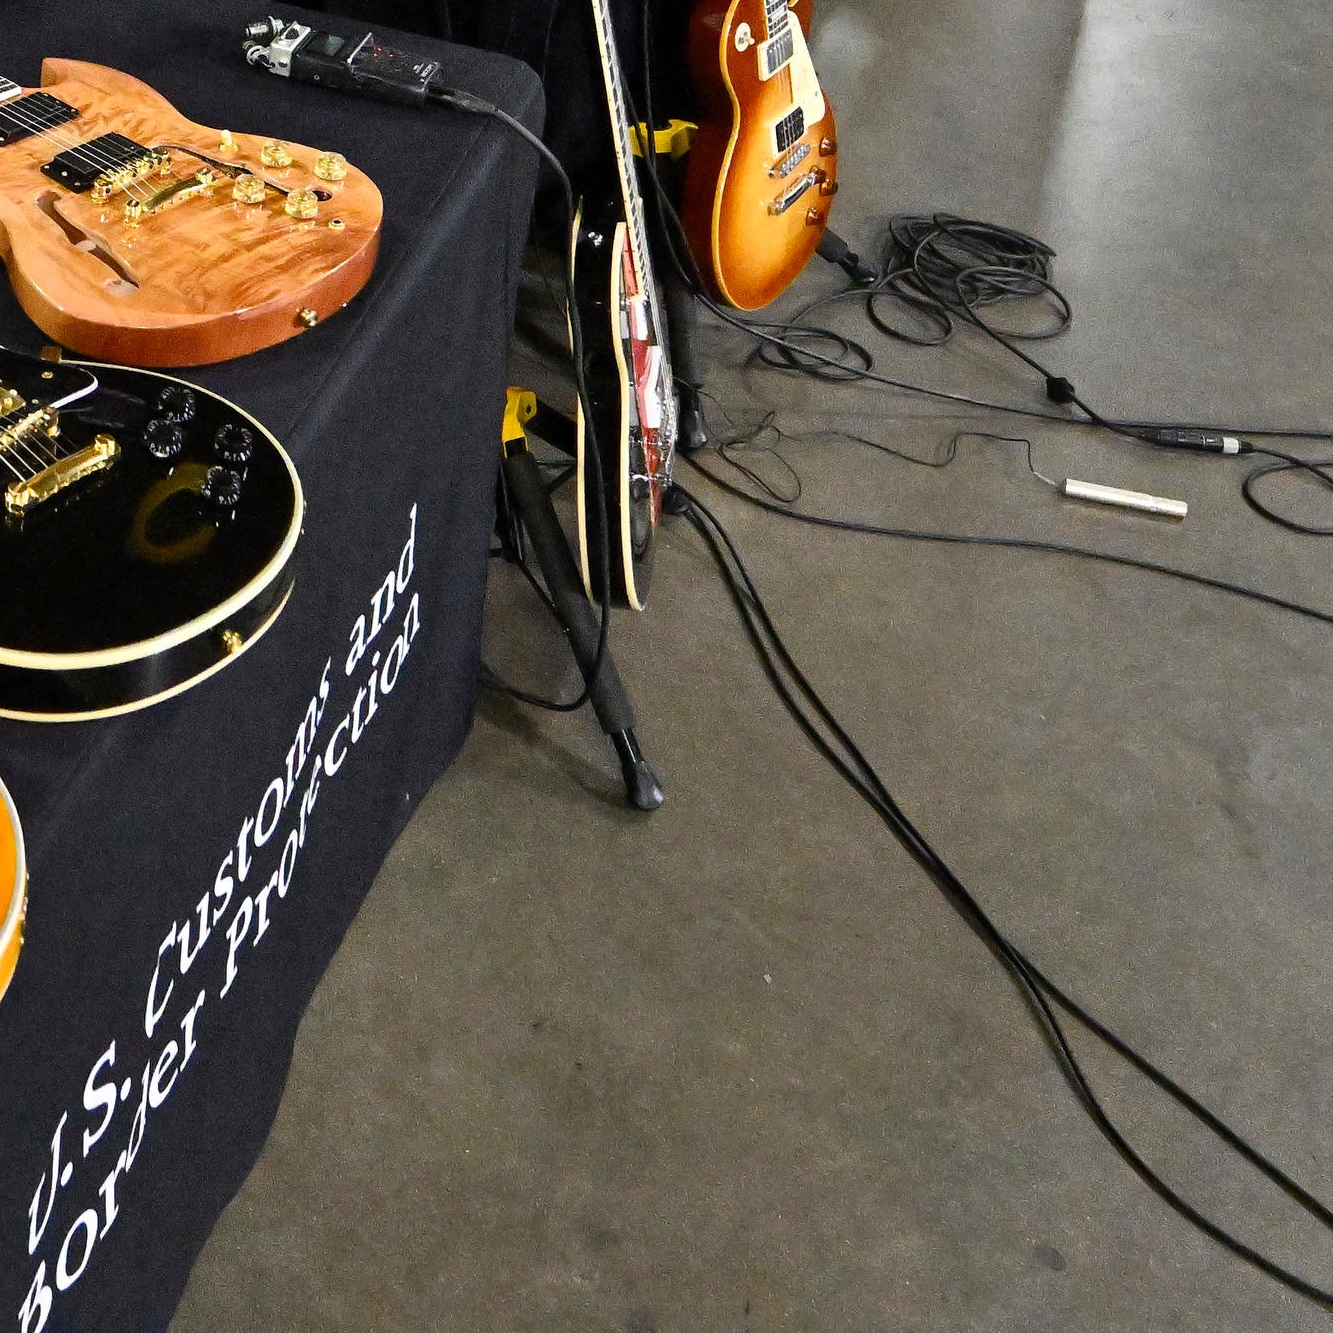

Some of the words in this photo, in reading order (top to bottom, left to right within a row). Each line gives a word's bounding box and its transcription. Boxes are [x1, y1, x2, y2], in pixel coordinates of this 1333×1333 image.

[18, 994, 206, 1333] Border
[222, 591, 421, 998] Protection
[28, 1040, 132, 1256] U.S.
[145, 655, 332, 1038] Customs
[345, 503, 417, 676] and
